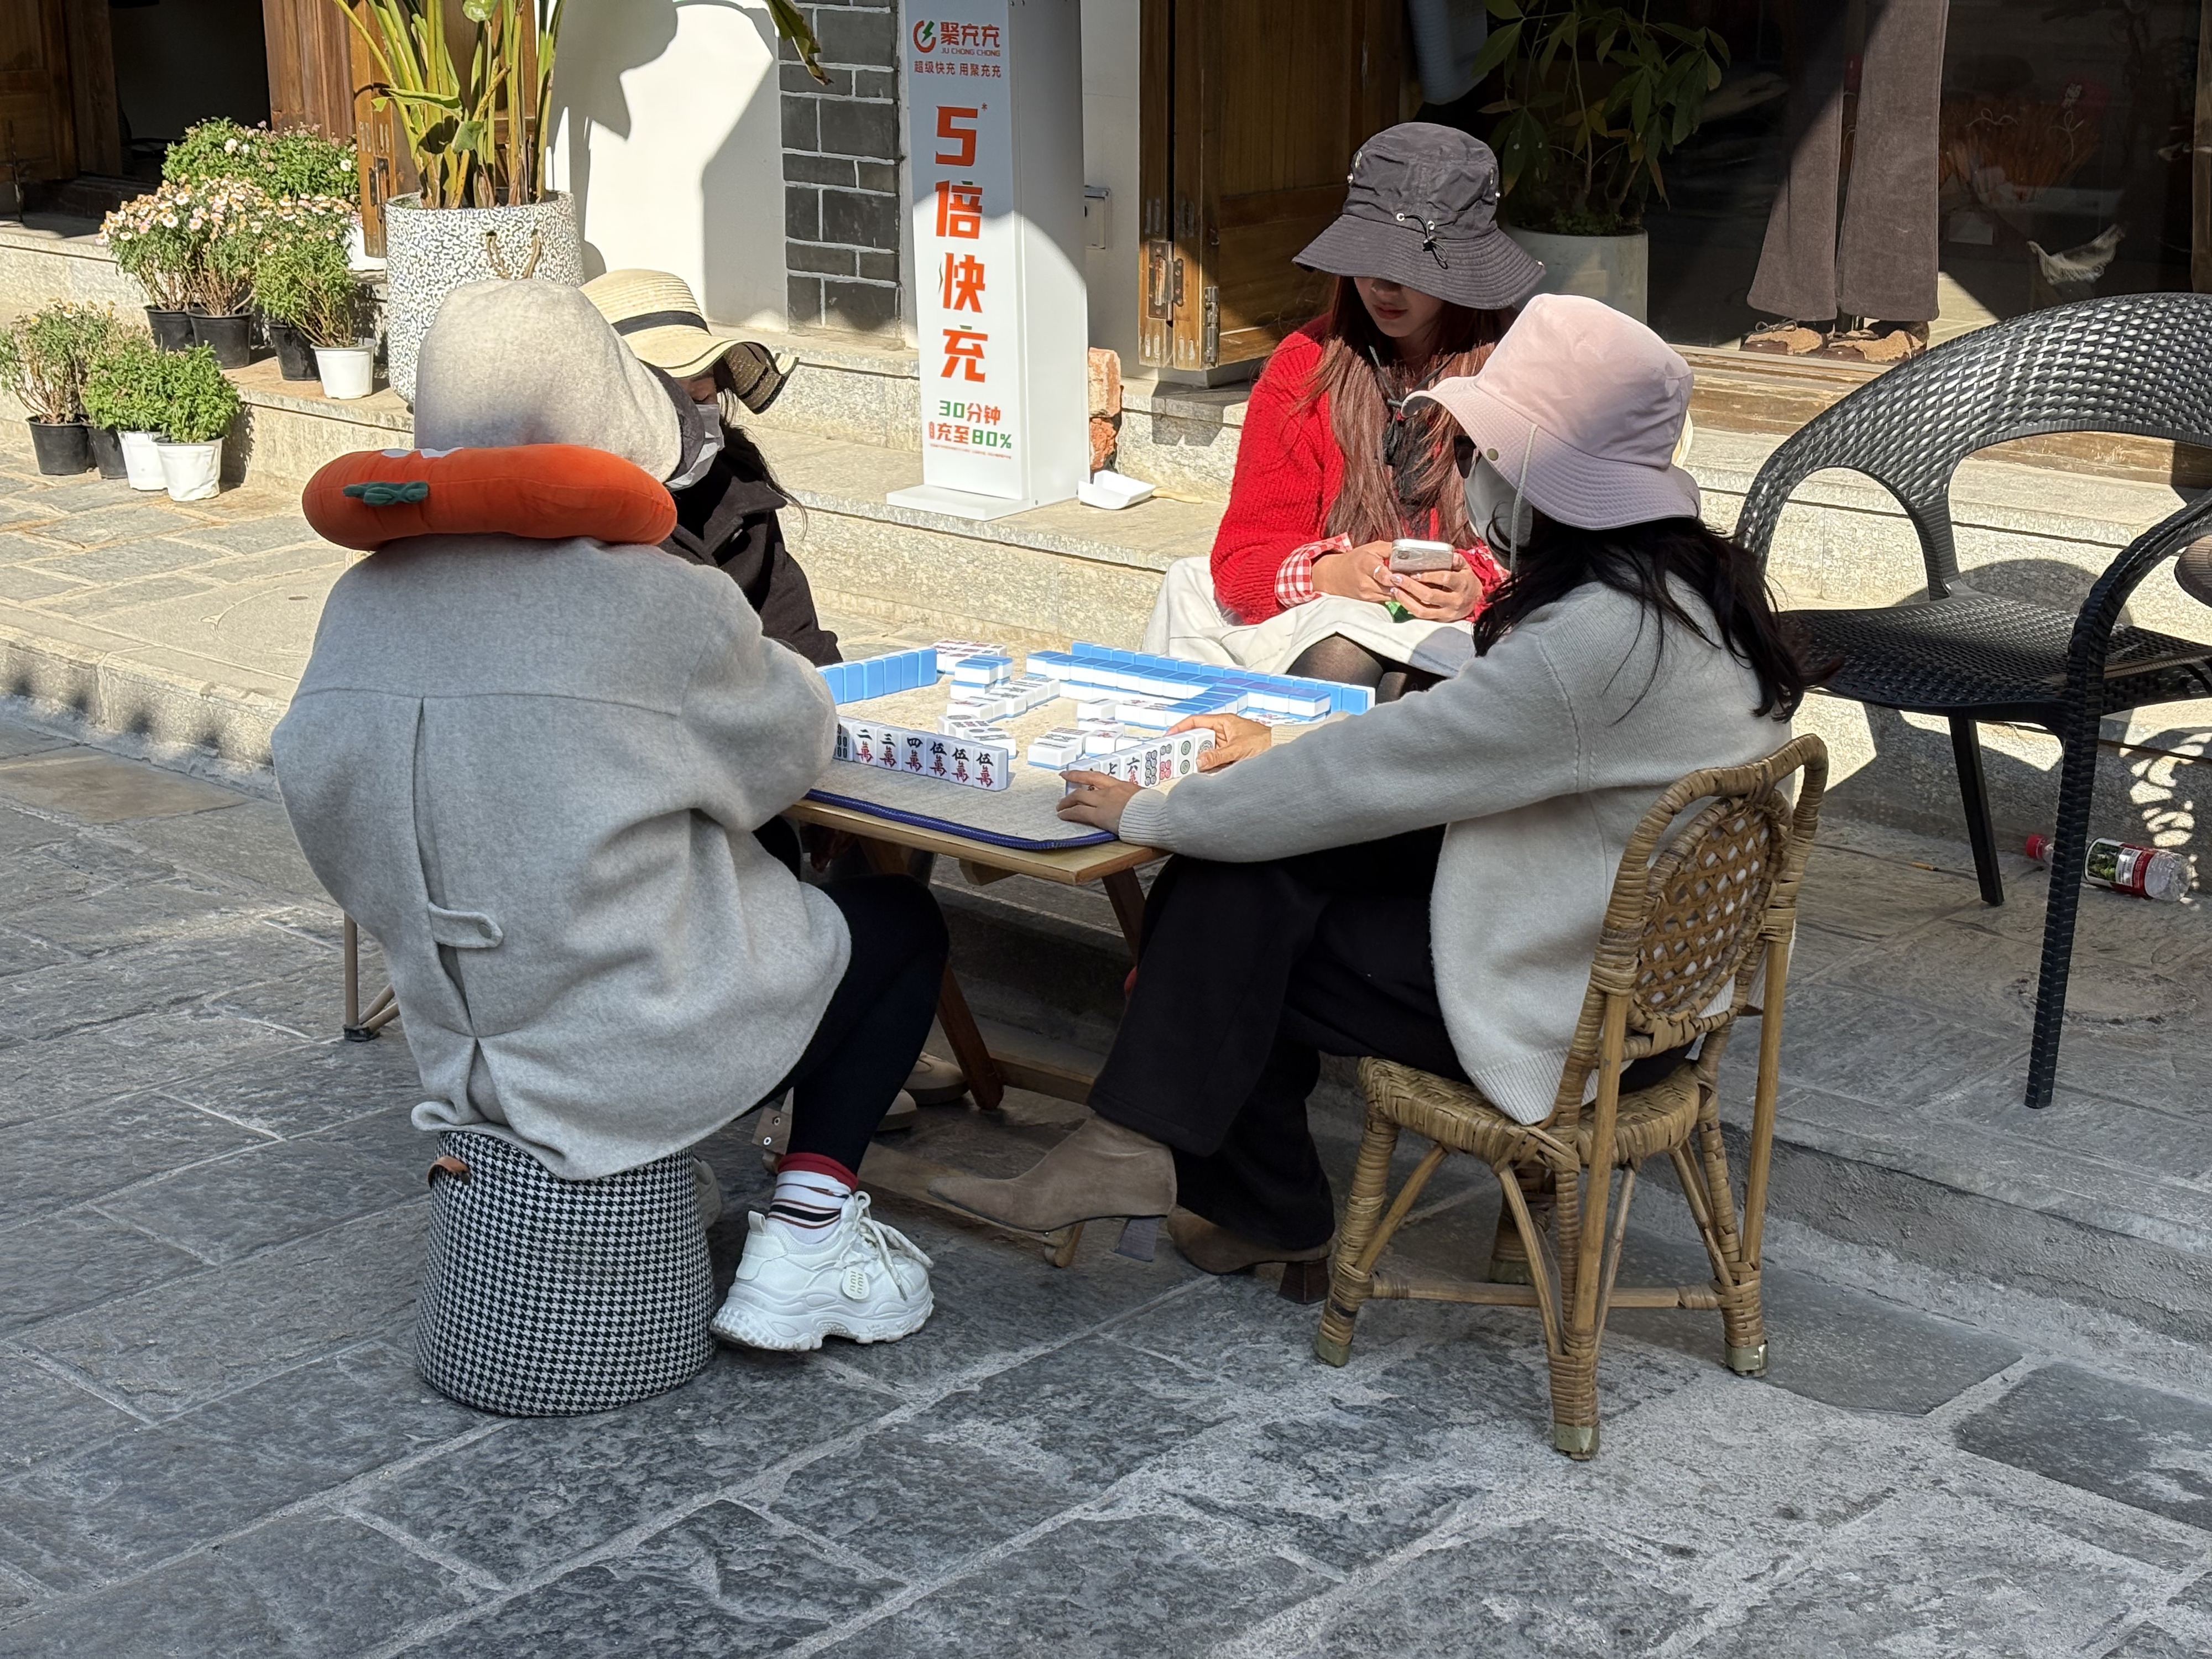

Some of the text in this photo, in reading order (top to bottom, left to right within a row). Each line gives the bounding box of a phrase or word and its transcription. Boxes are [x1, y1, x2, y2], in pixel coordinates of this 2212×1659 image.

[941, 22, 1000, 48] 聚充充
[977, 49, 1001, 57] CHONG
[914, 60, 1001, 78] 超级快充 用聚充充
[938, 399, 1001, 426] 30分钟
[937, 422, 1013, 449] 充至80%
